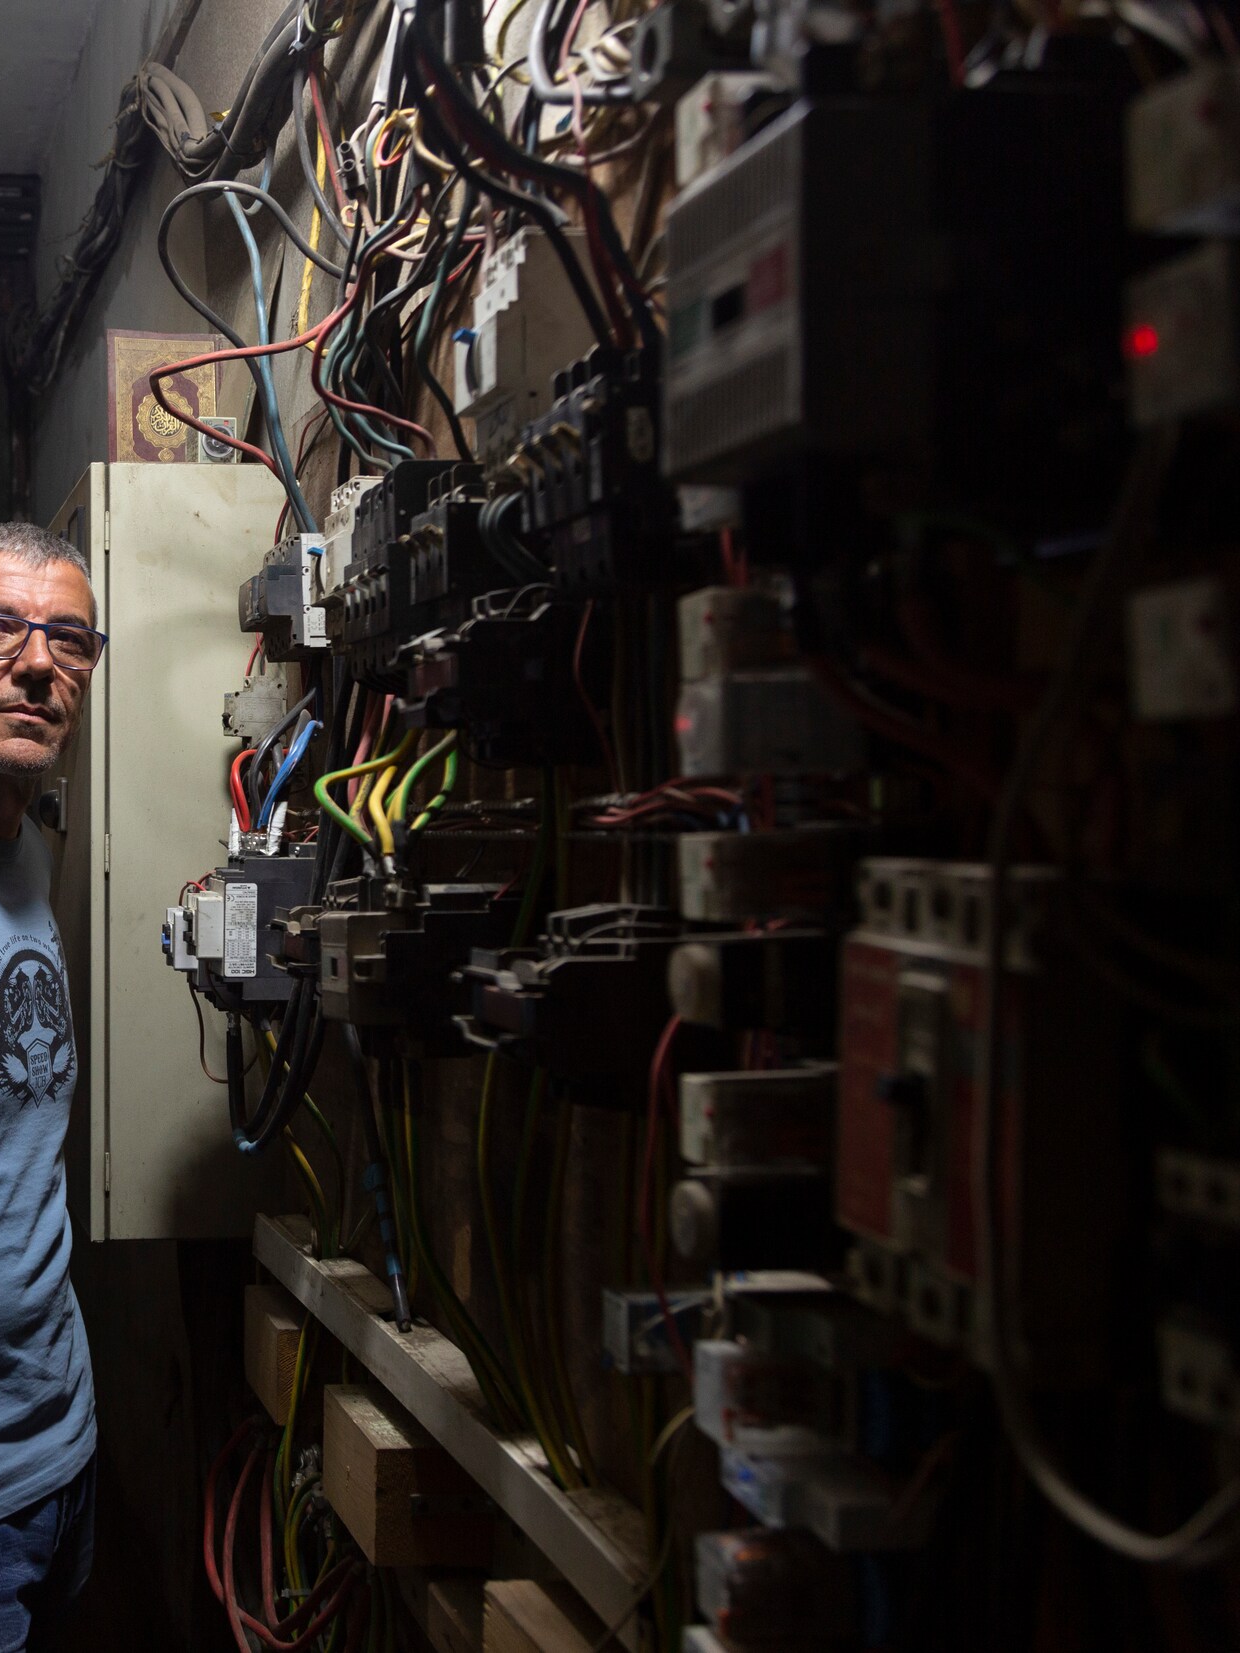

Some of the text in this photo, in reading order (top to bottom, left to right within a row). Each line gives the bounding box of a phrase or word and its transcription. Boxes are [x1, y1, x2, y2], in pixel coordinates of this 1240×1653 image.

[9, 934, 21, 944] life
[30, 1052, 48, 1065] SPEED
[32, 1063, 48, 1076] SHOW
